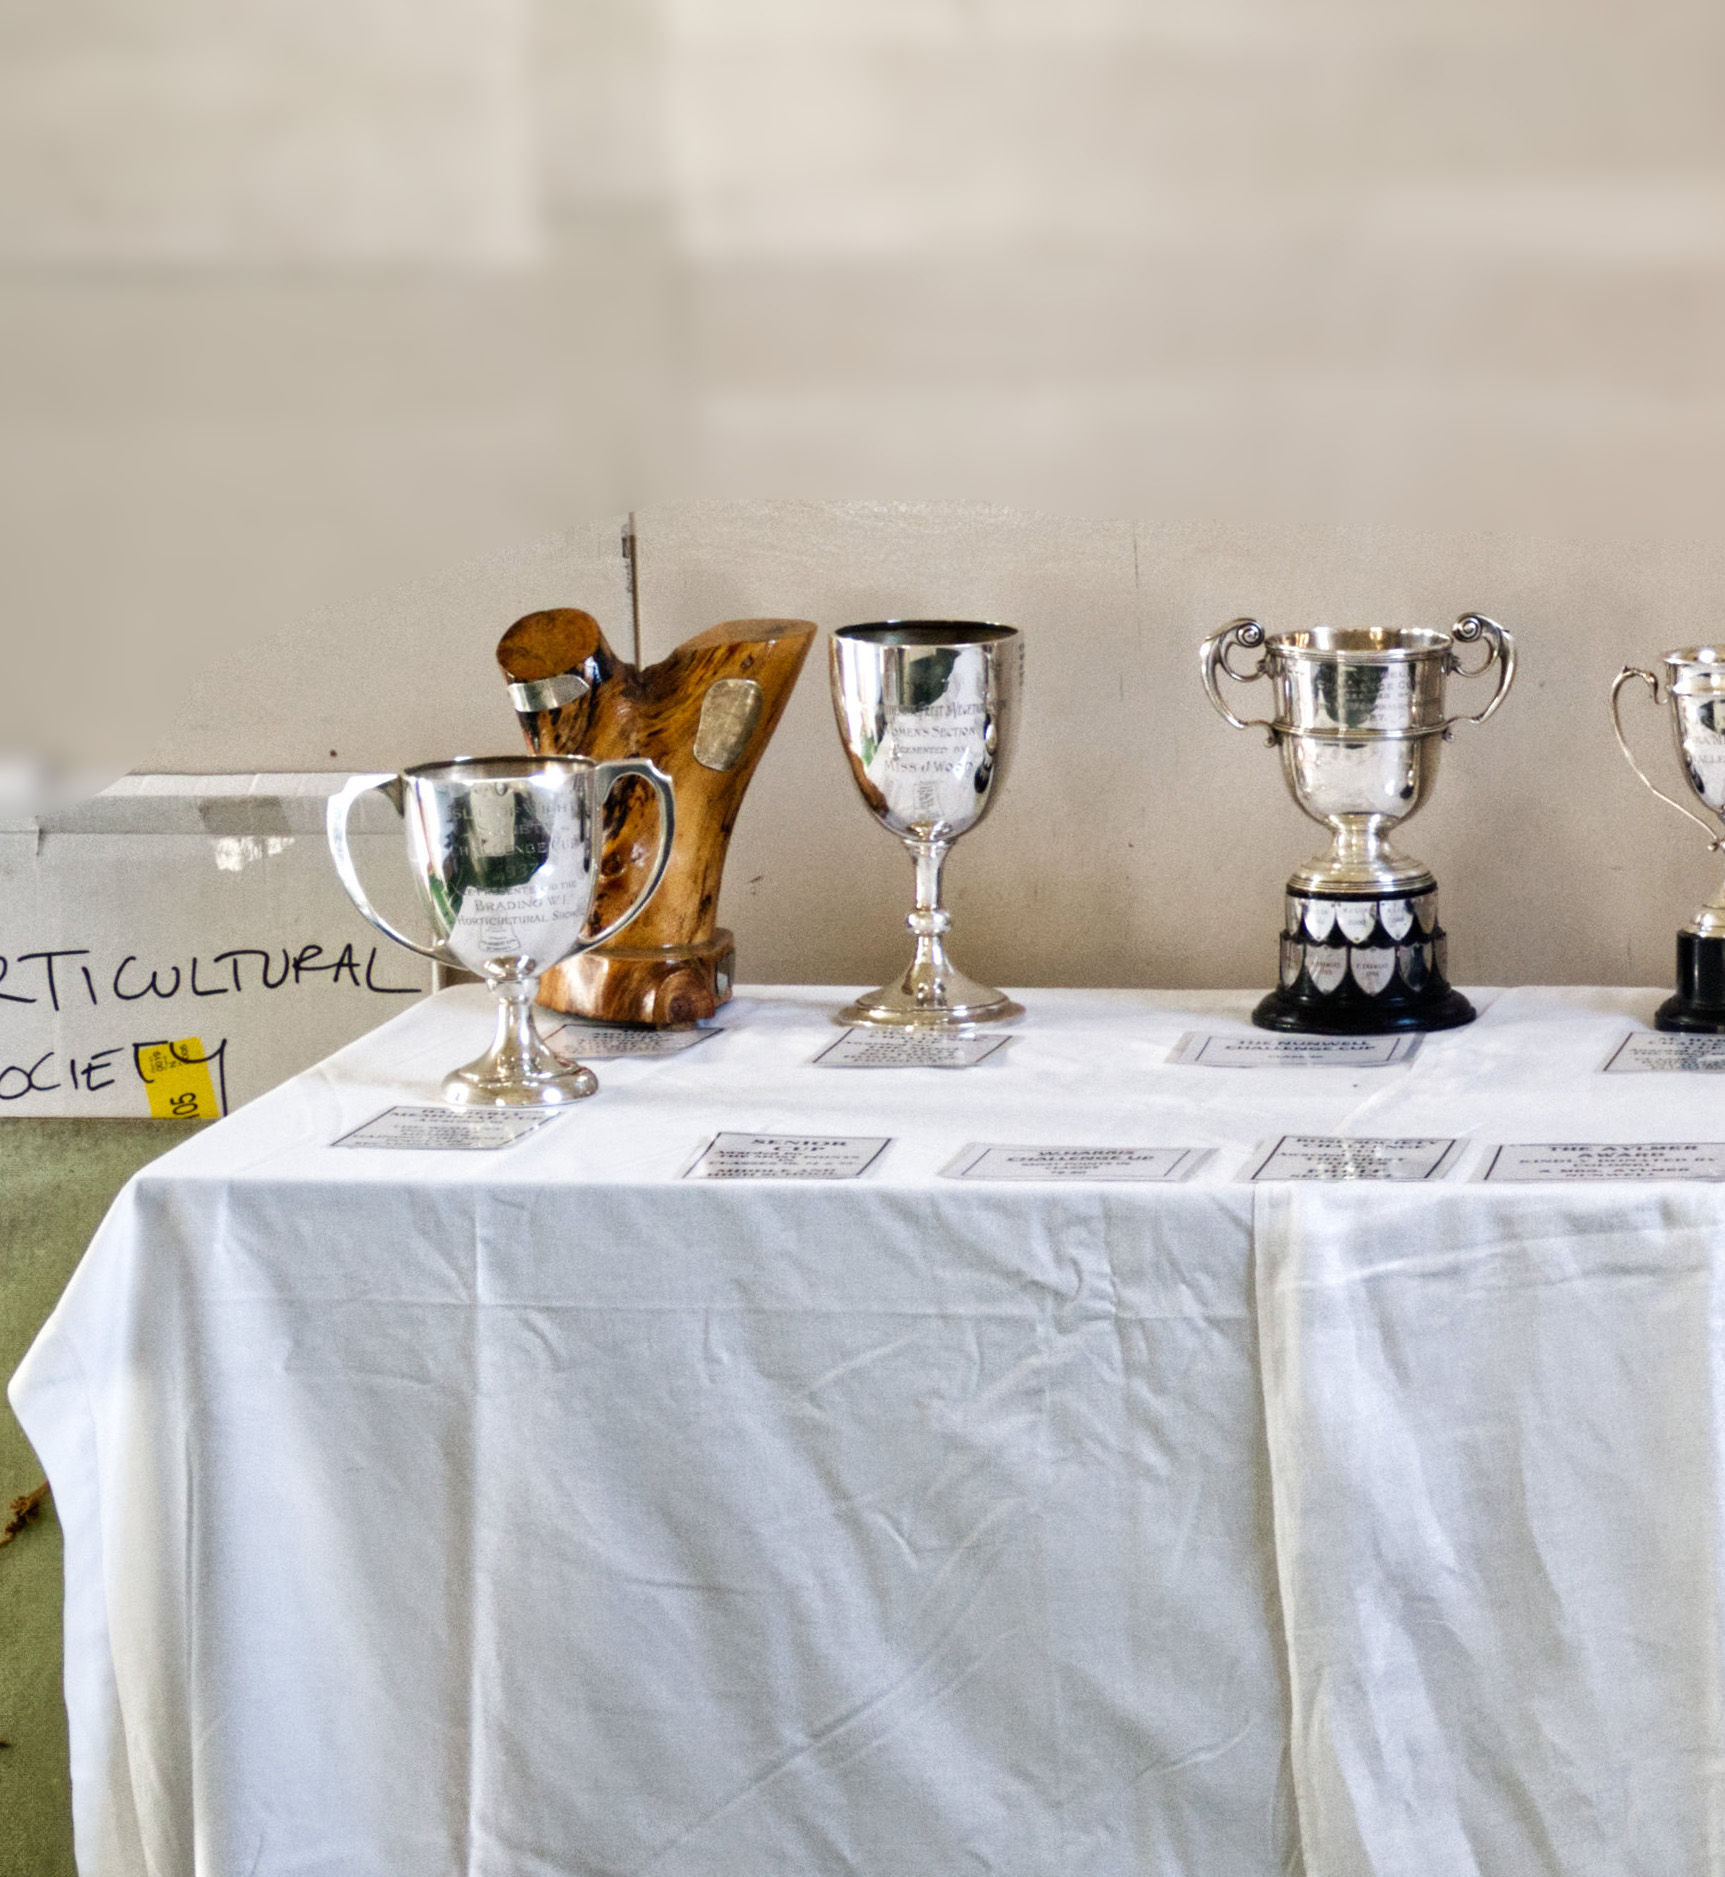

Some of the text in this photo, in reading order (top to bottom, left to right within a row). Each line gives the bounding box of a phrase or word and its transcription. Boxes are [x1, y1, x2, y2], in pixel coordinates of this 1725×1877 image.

[474, 898, 543, 913] BRADING
[751, 1138, 848, 1147] SENIOR
[1600, 1144, 1698, 1152] AYLMER
[1007, 1155, 1121, 1163] CHALLENGE
[1577, 1151, 1666, 1159] AWARD
